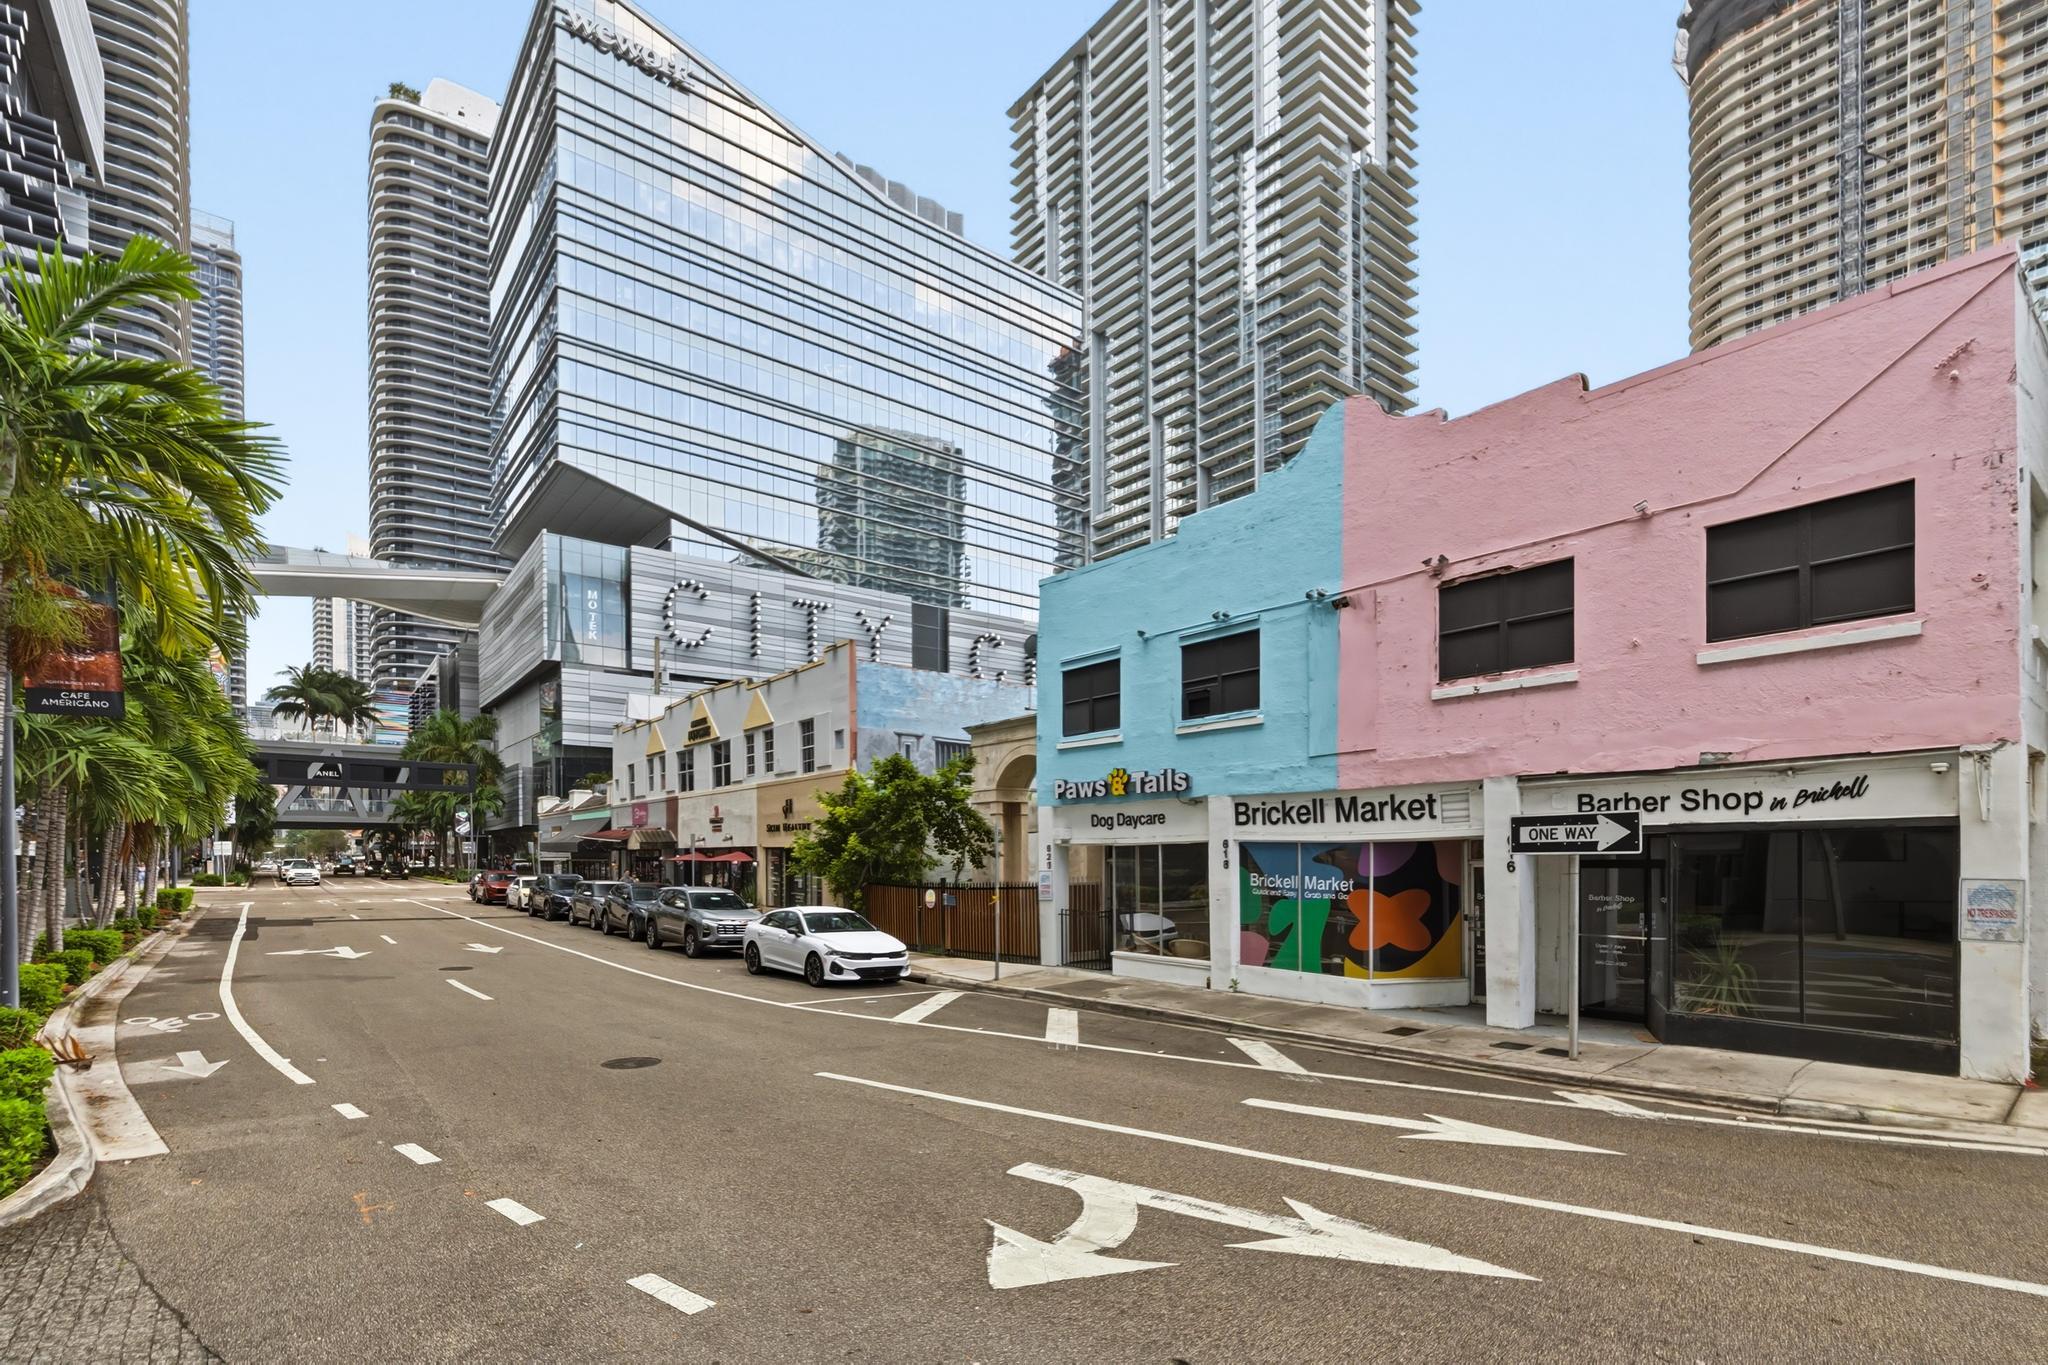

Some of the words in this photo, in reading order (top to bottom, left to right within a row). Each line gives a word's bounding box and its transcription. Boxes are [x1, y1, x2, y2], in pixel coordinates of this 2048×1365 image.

[563, 9, 697, 90] wework
[587, 590, 598, 640] MOTEK
[662, 579, 894, 663] CITY
[41, 698, 109, 708] AMERICANO
[60, 691, 90, 699] CAFE
[1054, 779, 1107, 800] Paws
[1131, 768, 1190, 794] Tails
[1576, 792, 1671, 813] Barber
[1680, 788, 1764, 815] Shop
[1769, 796, 1787, 811] in
[1792, 774, 1869, 809] Brickell
[1091, 814, 1114, 830] Dog
[1117, 812, 1166, 829] Daycare
[1233, 798, 1325, 826] Brickell
[1334, 793, 1438, 823] Market
[1528, 827, 1559, 841] ONE
[1564, 826, 1597, 840] WAY
[1249, 873, 1299, 889] Brickell
[1304, 875, 1354, 892] Market
[1615, 895, 1635, 903] Shop
